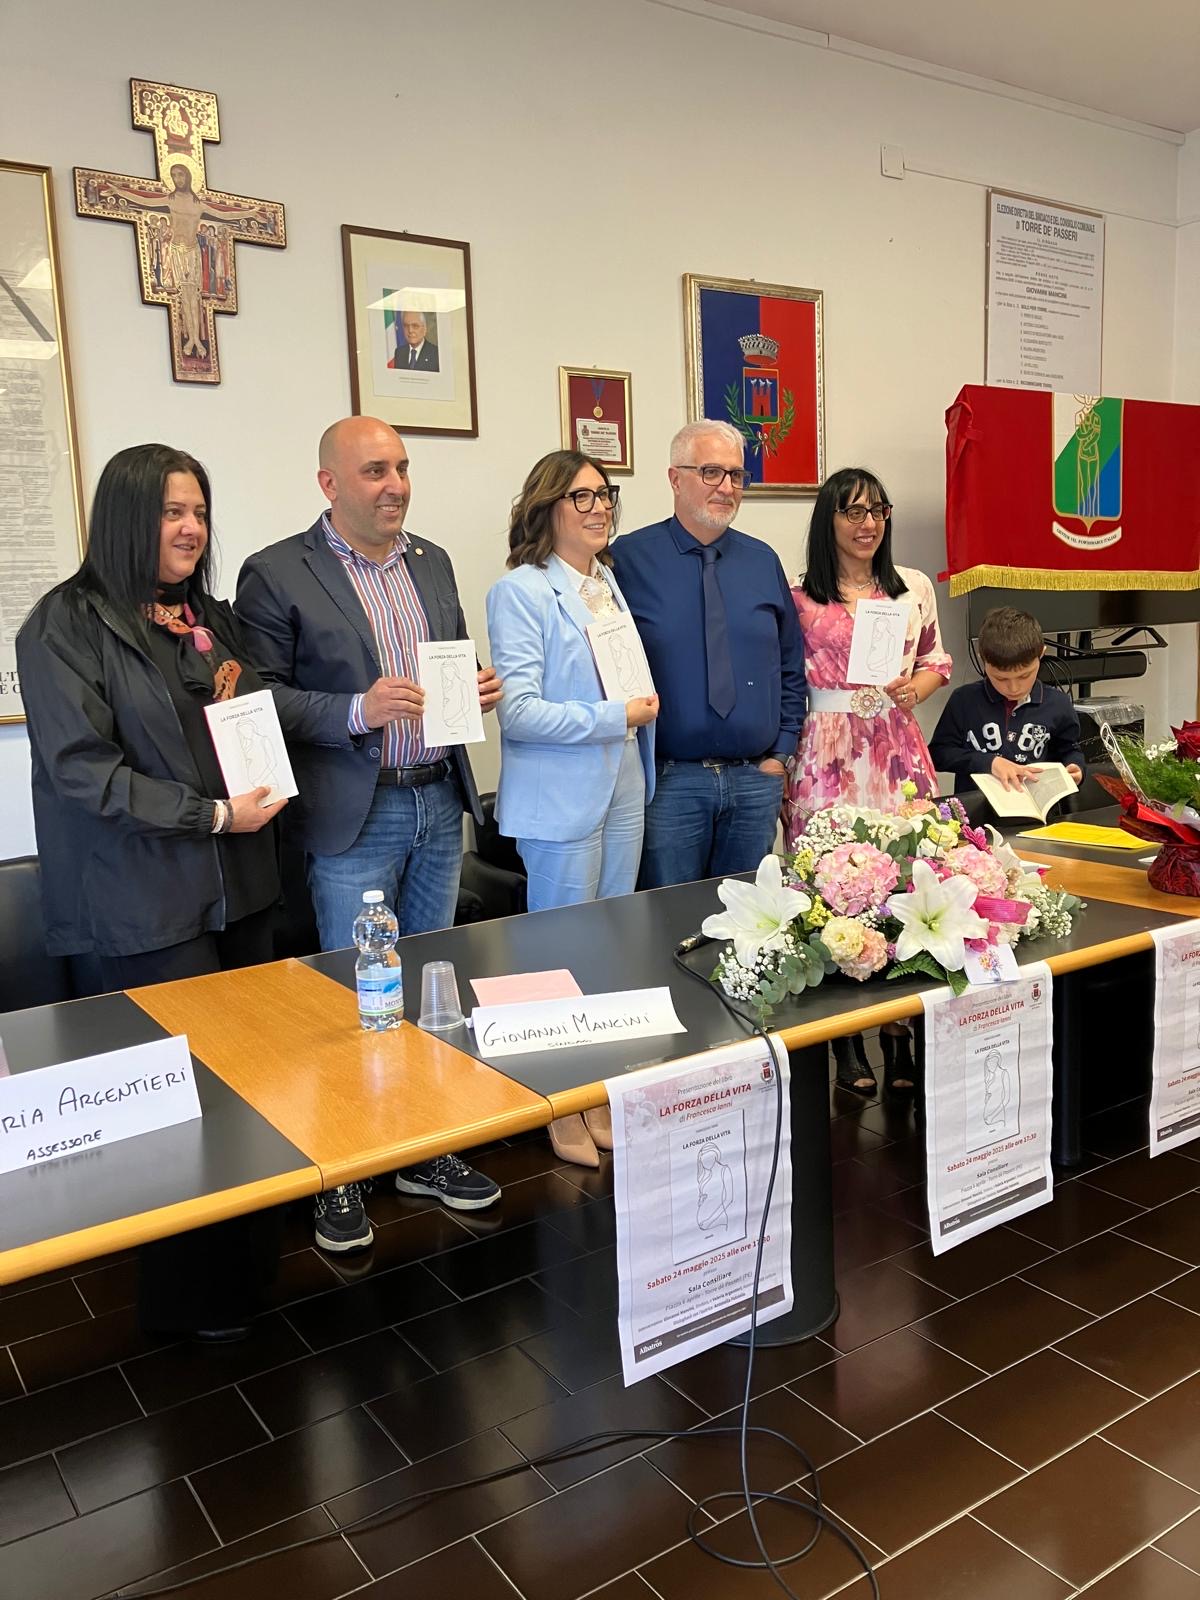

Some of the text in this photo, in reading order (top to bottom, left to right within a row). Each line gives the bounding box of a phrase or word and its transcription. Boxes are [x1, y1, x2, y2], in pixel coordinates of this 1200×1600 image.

[1022, 220, 1042, 234] TORRE
[1054, 227, 1078, 242] PASSERI
[1189, 951, 1200, 959] FOR
[960, 1017, 967, 1026] LA
[968, 1010, 989, 1023] FORZA
[990, 1005, 1010, 1016] DELLA
[1010, 1000, 1024, 1011] VITA
[678, 1074, 733, 1096] Presentazione del libro
[660, 1107, 671, 1117] LA
[673, 1097, 702, 1114] FORZA
[704, 1090, 731, 1104] DELLA
[732, 1083, 752, 1095] VITA
[0, 1108, 44, 1134] RIA
[679, 1115, 685, 1123] di
[690, 1138, 705, 1148] FORZA
[705, 1133, 721, 1142] DELLA
[947, 1133, 1037, 1172] Sabato 24 maggio 2025 alle ore 17:30
[647, 1274, 672, 1289] Sabato
[673, 1270, 682, 1279] 24
[683, 1260, 709, 1275] maggio
[710, 1253, 726, 1264] 2025
[727, 1248, 740, 1258] alle
[740, 1243, 752, 1252] ore
[688, 1271, 732, 1293] Sala Consiliare
[640, 1339, 662, 1355] Albatros
